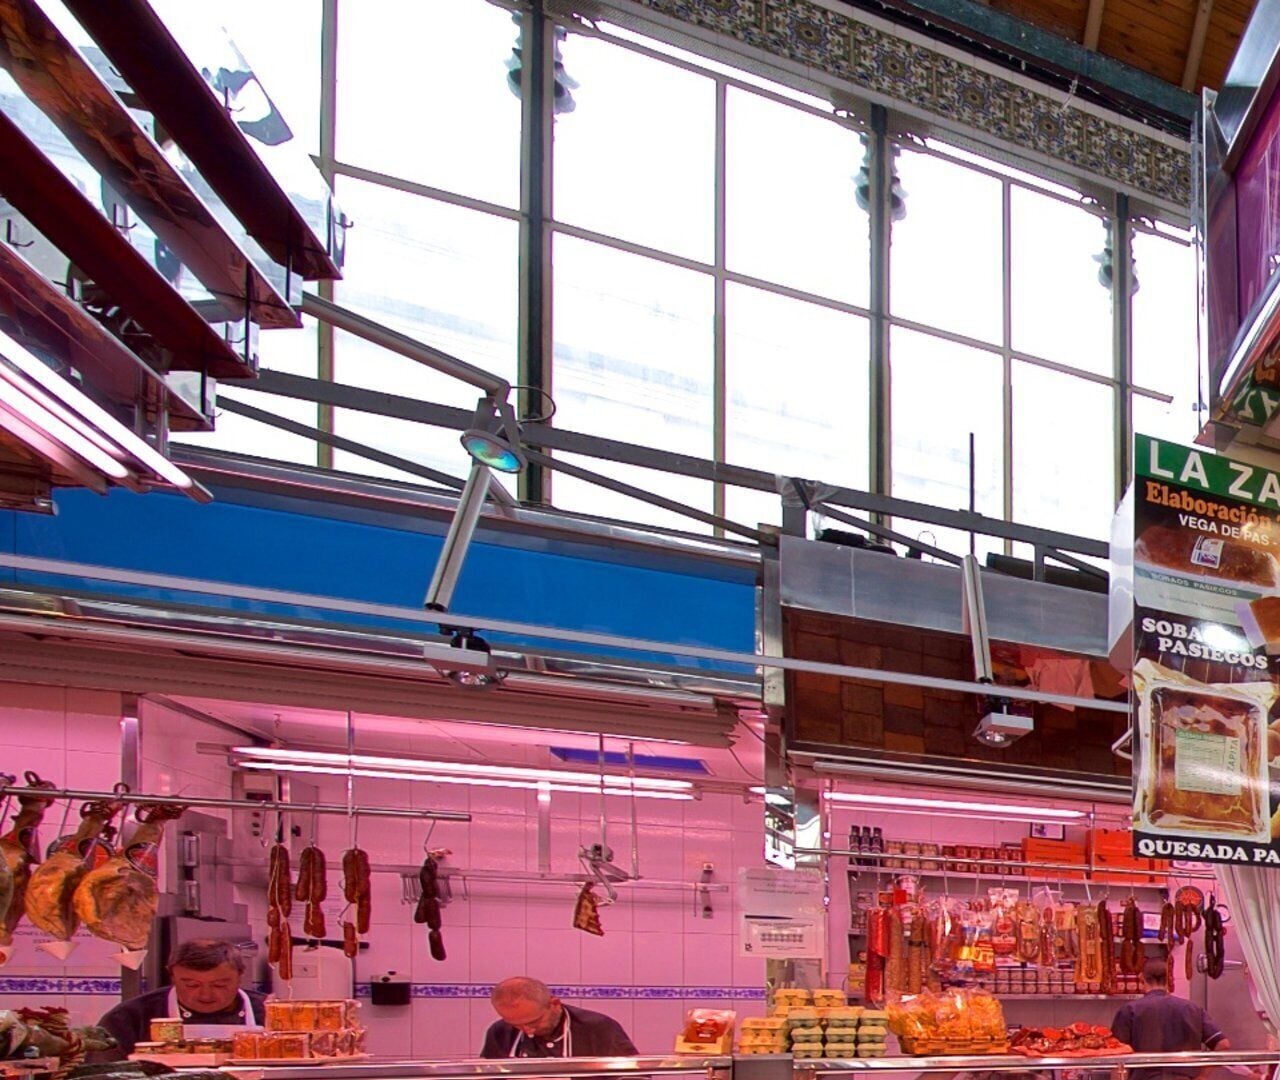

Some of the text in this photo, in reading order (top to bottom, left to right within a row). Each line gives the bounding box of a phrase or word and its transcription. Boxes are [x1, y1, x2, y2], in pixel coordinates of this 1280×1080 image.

[1150, 440, 1210, 488] LA
[1145, 480, 1272, 533] Elaboración
[1179, 513, 1218, 534] VEGA
[1221, 523, 1241, 539] DE
[1243, 527, 1269, 547] PAS
[1157, 636, 1269, 670] PASIEGOS
[1138, 838, 1249, 862] QUESADA
